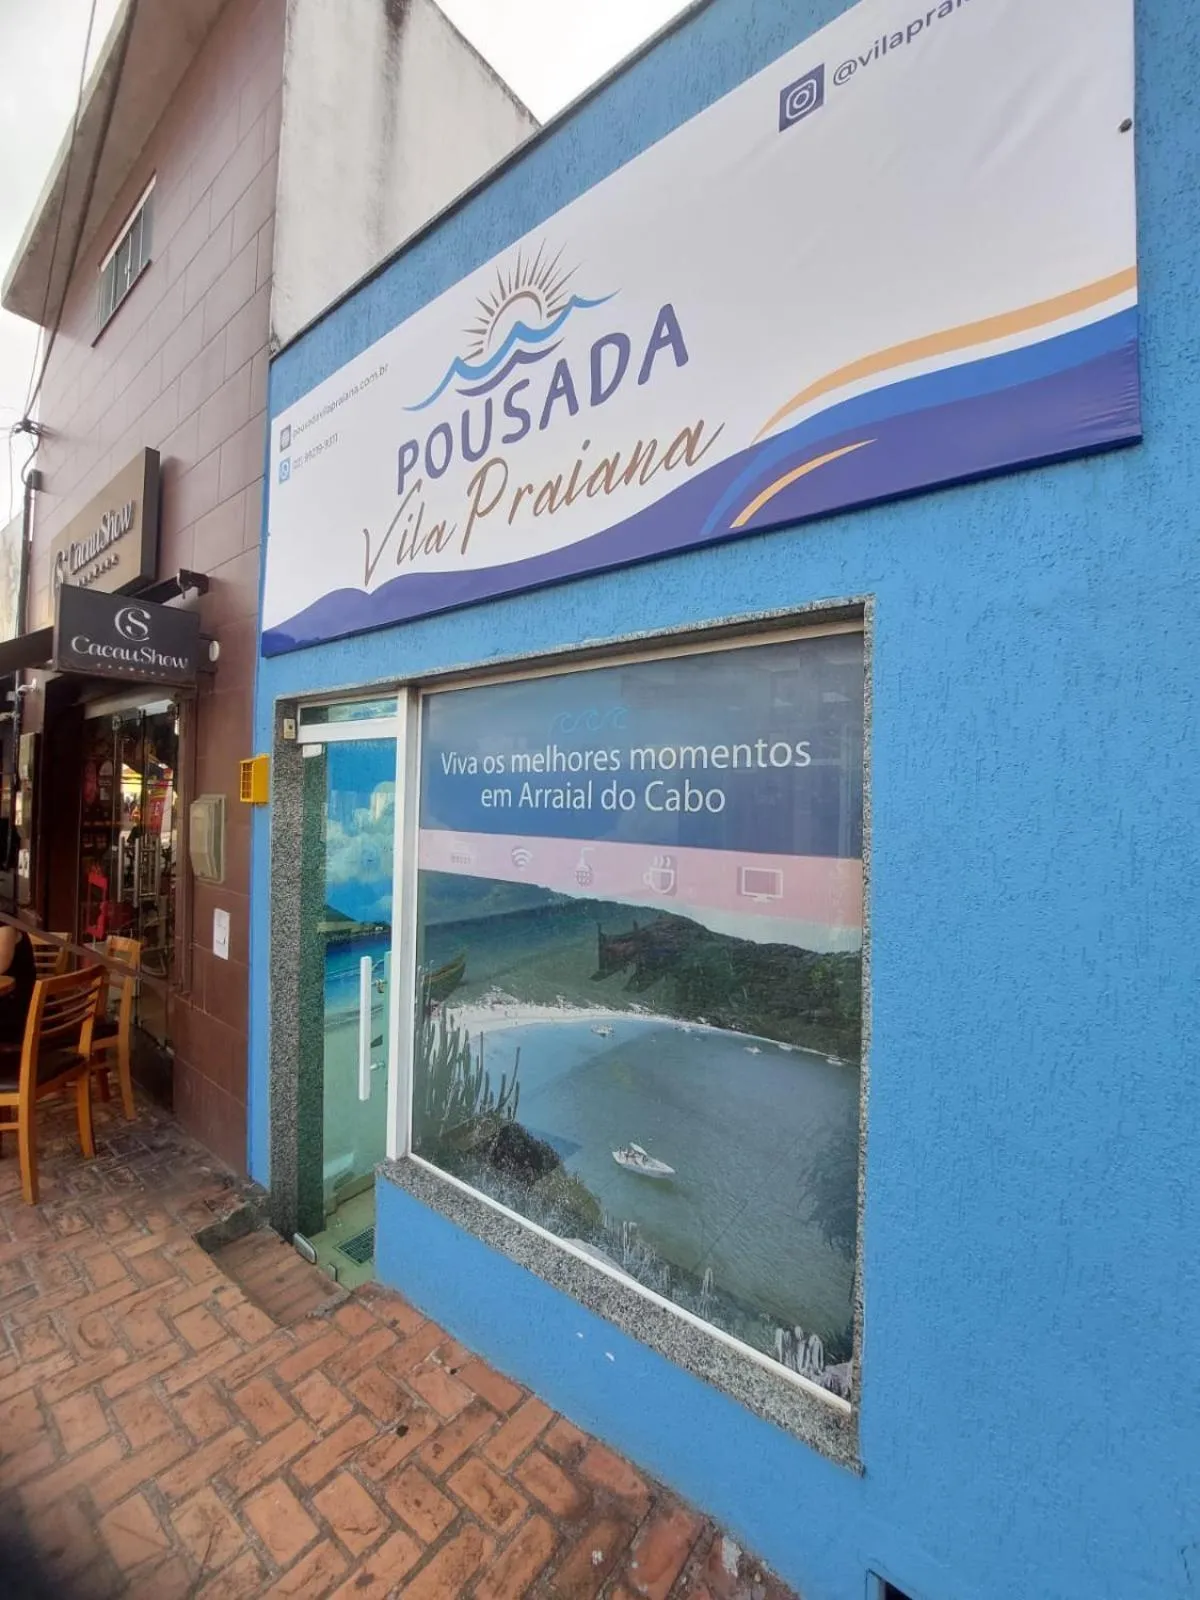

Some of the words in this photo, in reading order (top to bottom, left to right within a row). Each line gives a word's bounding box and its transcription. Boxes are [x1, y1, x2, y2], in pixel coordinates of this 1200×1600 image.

[397, 303, 689, 496] POUSADA
[363, 478, 457, 587] Vila
[460, 419, 725, 556] Praiana
[441, 752, 478, 776] Viva
[482, 757, 505, 774] os
[511, 745, 621, 774] melhores
[629, 738, 812, 770] momentos
[480, 787, 512, 808] em
[518, 780, 593, 810] Arraial
[600, 780, 636, 811] do
[644, 780, 726, 814] Cabo
